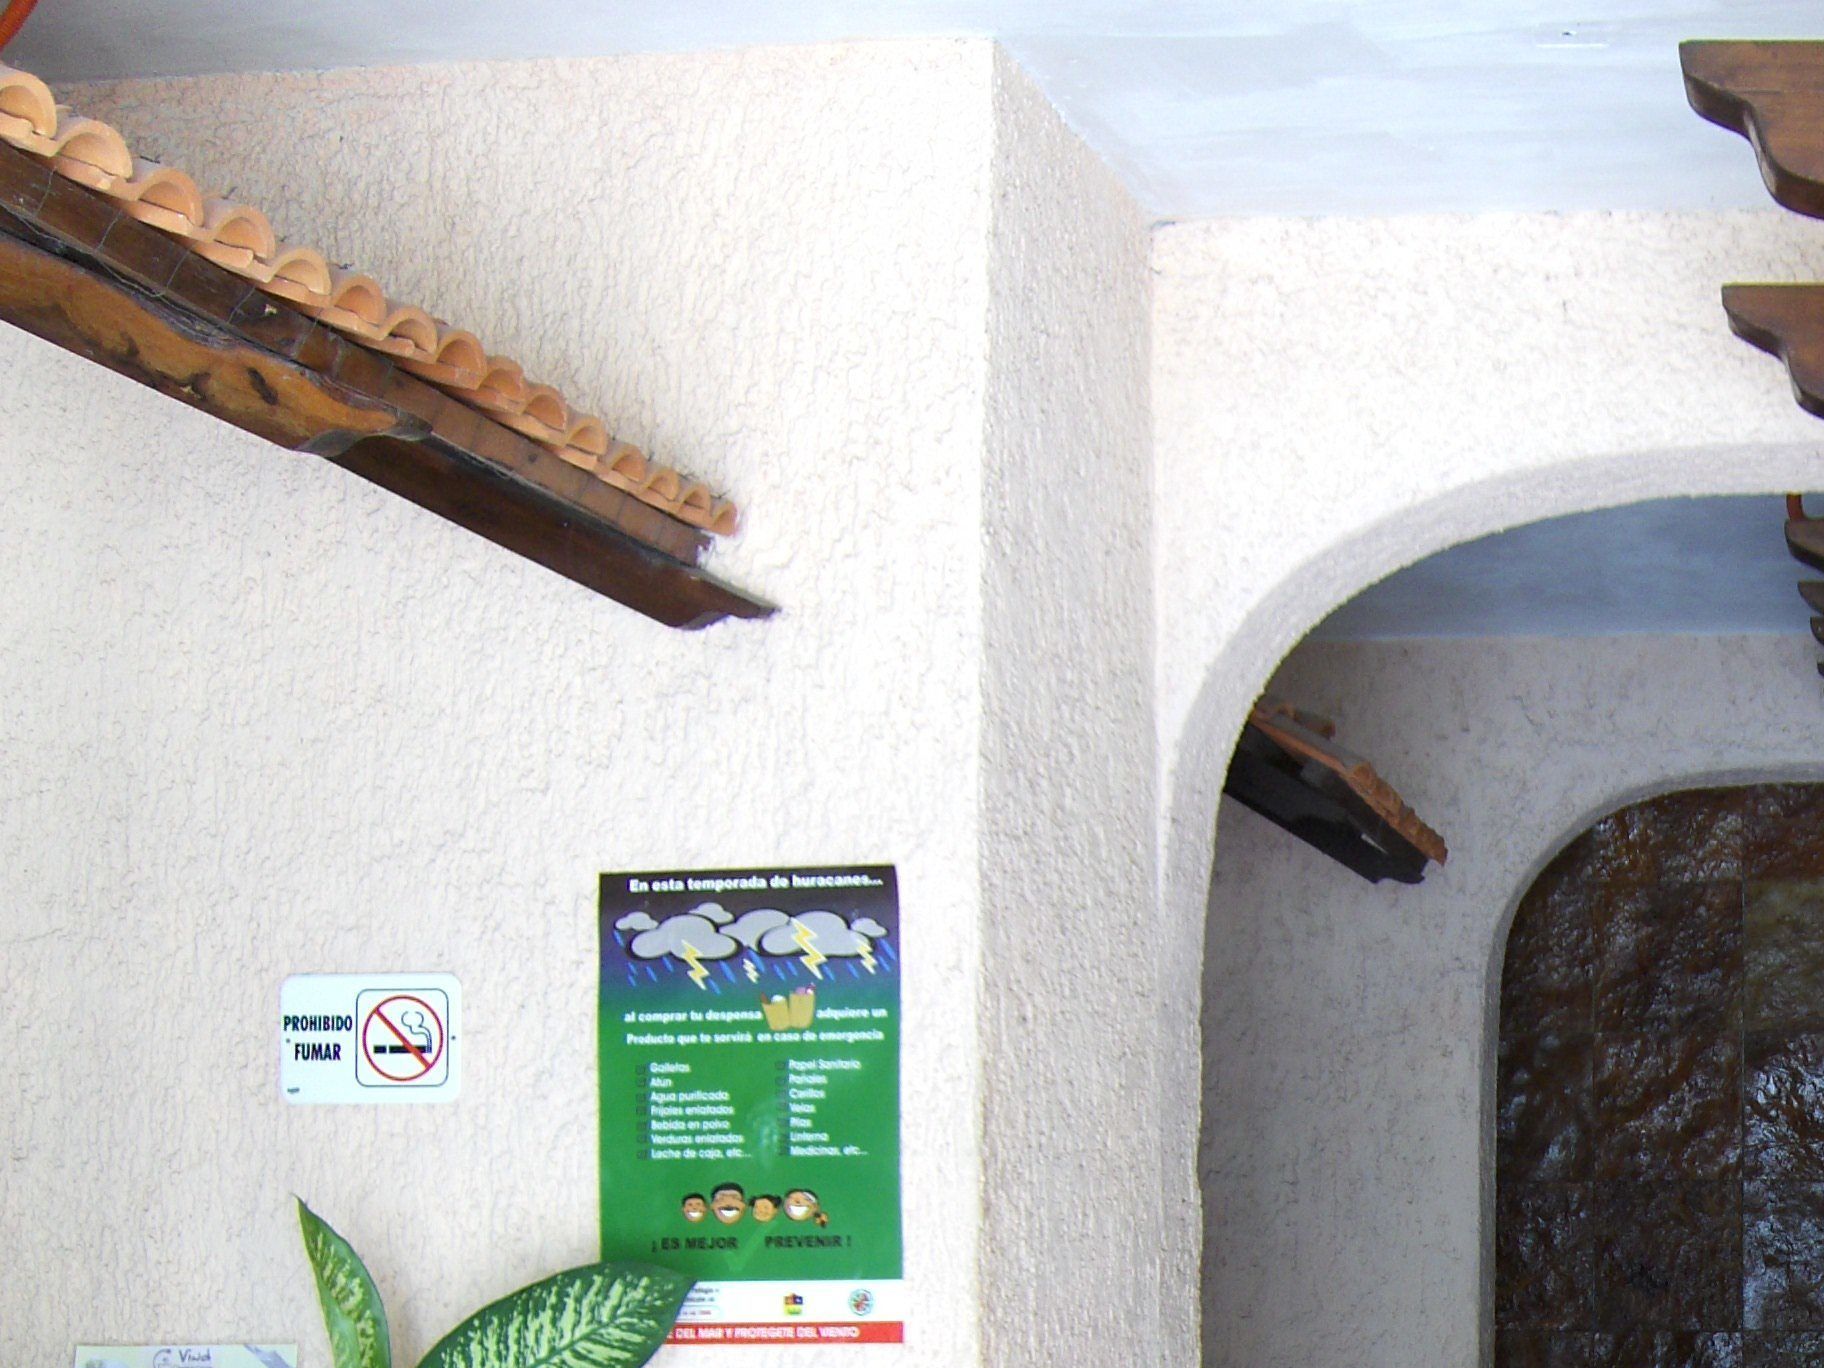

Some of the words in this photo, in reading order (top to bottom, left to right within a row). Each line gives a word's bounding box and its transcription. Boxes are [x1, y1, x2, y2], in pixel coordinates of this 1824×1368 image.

[630, 879, 650, 893] En
[652, 878, 685, 892] esta
[687, 876, 767, 893] temporada
[770, 875, 790, 889] de
[624, 1010, 636, 1022] al
[638, 1012, 688, 1024] comprar
[690, 1010, 704, 1021] tu
[705, 1009, 763, 1022] despensa
[816, 1007, 869, 1020] adquiere
[871, 1008, 888, 1018] un
[283, 1015, 353, 1031] PROHIBIDO
[627, 1033, 675, 1045] Producto
[677, 1034, 698, 1046] que
[757, 1032, 772, 1042] en
[773, 1032, 801, 1042] caso
[802, 1030, 818, 1042] de
[819, 1028, 885, 1043] emergencia
[294, 1043, 342, 1061] FUMAR
[685, 1237, 739, 1250] MEJOR
[764, 1235, 842, 1249] PREVENIR
